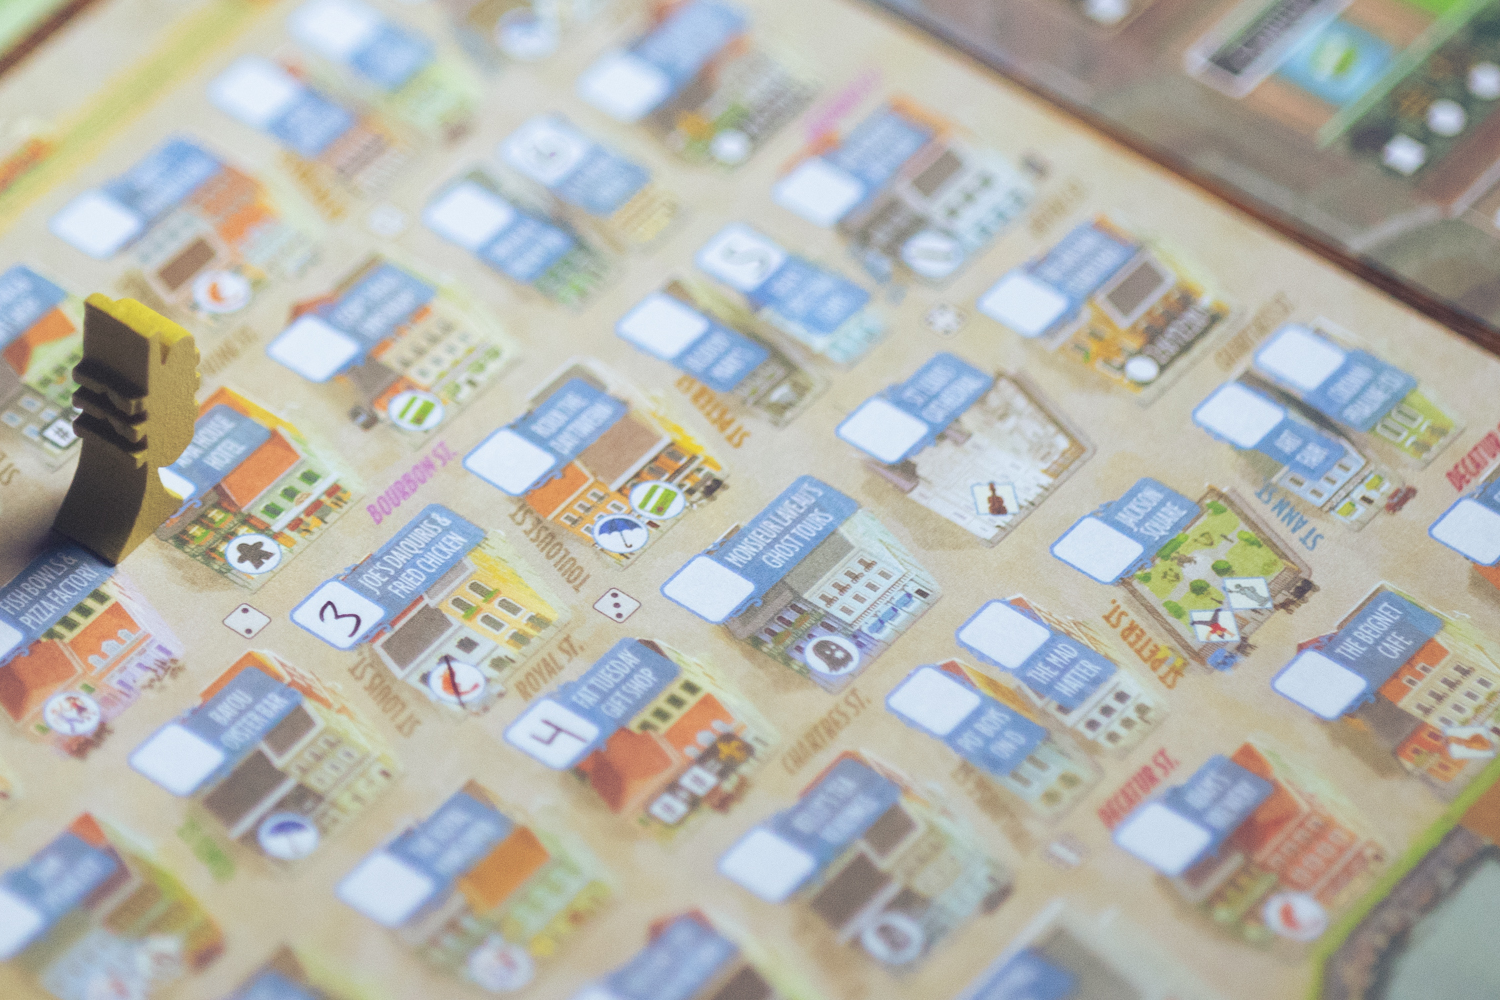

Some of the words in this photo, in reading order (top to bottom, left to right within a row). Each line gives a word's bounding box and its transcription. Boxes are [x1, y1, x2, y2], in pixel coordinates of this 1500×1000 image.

[1114, 485, 1165, 532] JACKSON
[1139, 501, 1188, 541] SQUARE
[1274, 498, 1309, 534] ANN
[358, 561, 395, 596] JOE'S
[385, 519, 441, 572] DAIQUIRIS
[431, 512, 452, 527] &
[523, 517, 591, 593] TOULOUSE
[724, 513, 781, 568] MONSIEUR
[762, 530, 801, 569] GHOST
[791, 508, 834, 542] TOURS
[23, 561, 67, 598] BOWLS
[57, 551, 78, 566] &
[388, 567, 427, 599] FRIED
[416, 531, 468, 573] CHICKEN
[19, 602, 56, 630] PIZZA
[48, 563, 99, 608] FACTORY
[319, 600, 362, 638] 3
[1102, 598, 1128, 630] ST.
[1119, 619, 1169, 673] PETER
[1334, 637, 1368, 661] THE
[1353, 601, 1403, 645] BEIGNET
[1376, 631, 1414, 660] CAFE
[514, 652, 565, 702] ROYAL
[572, 682, 601, 709] FAT
[591, 647, 640, 694] TUESDAY
[1026, 657, 1059, 685] THE
[1046, 642, 1079, 672] MAD
[1053, 659, 1102, 698] HATTER
[207, 688, 253, 727] BAYOU
[254, 691, 289, 719] BAR
[600, 688, 630, 719] GIFT
[625, 667, 658, 700] SHOP
[530, 718, 588, 745] 4
